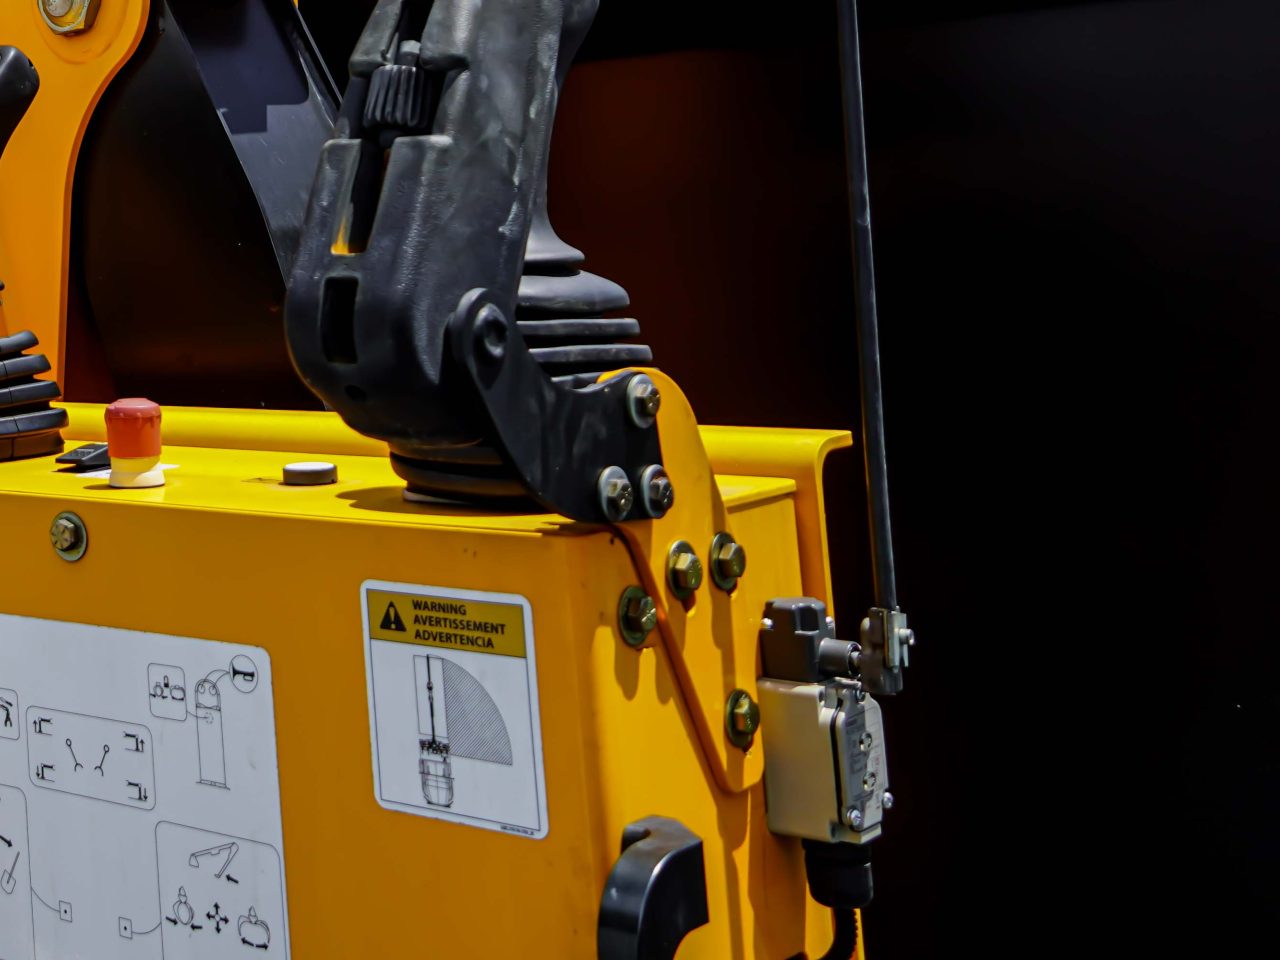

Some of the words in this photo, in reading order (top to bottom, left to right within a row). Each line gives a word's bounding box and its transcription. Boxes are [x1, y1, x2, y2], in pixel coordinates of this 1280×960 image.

[412, 599, 467, 616] WARNING
[413, 615, 506, 635] AVERTISSEMENT
[414, 631, 495, 649] ADVERTENCIA
